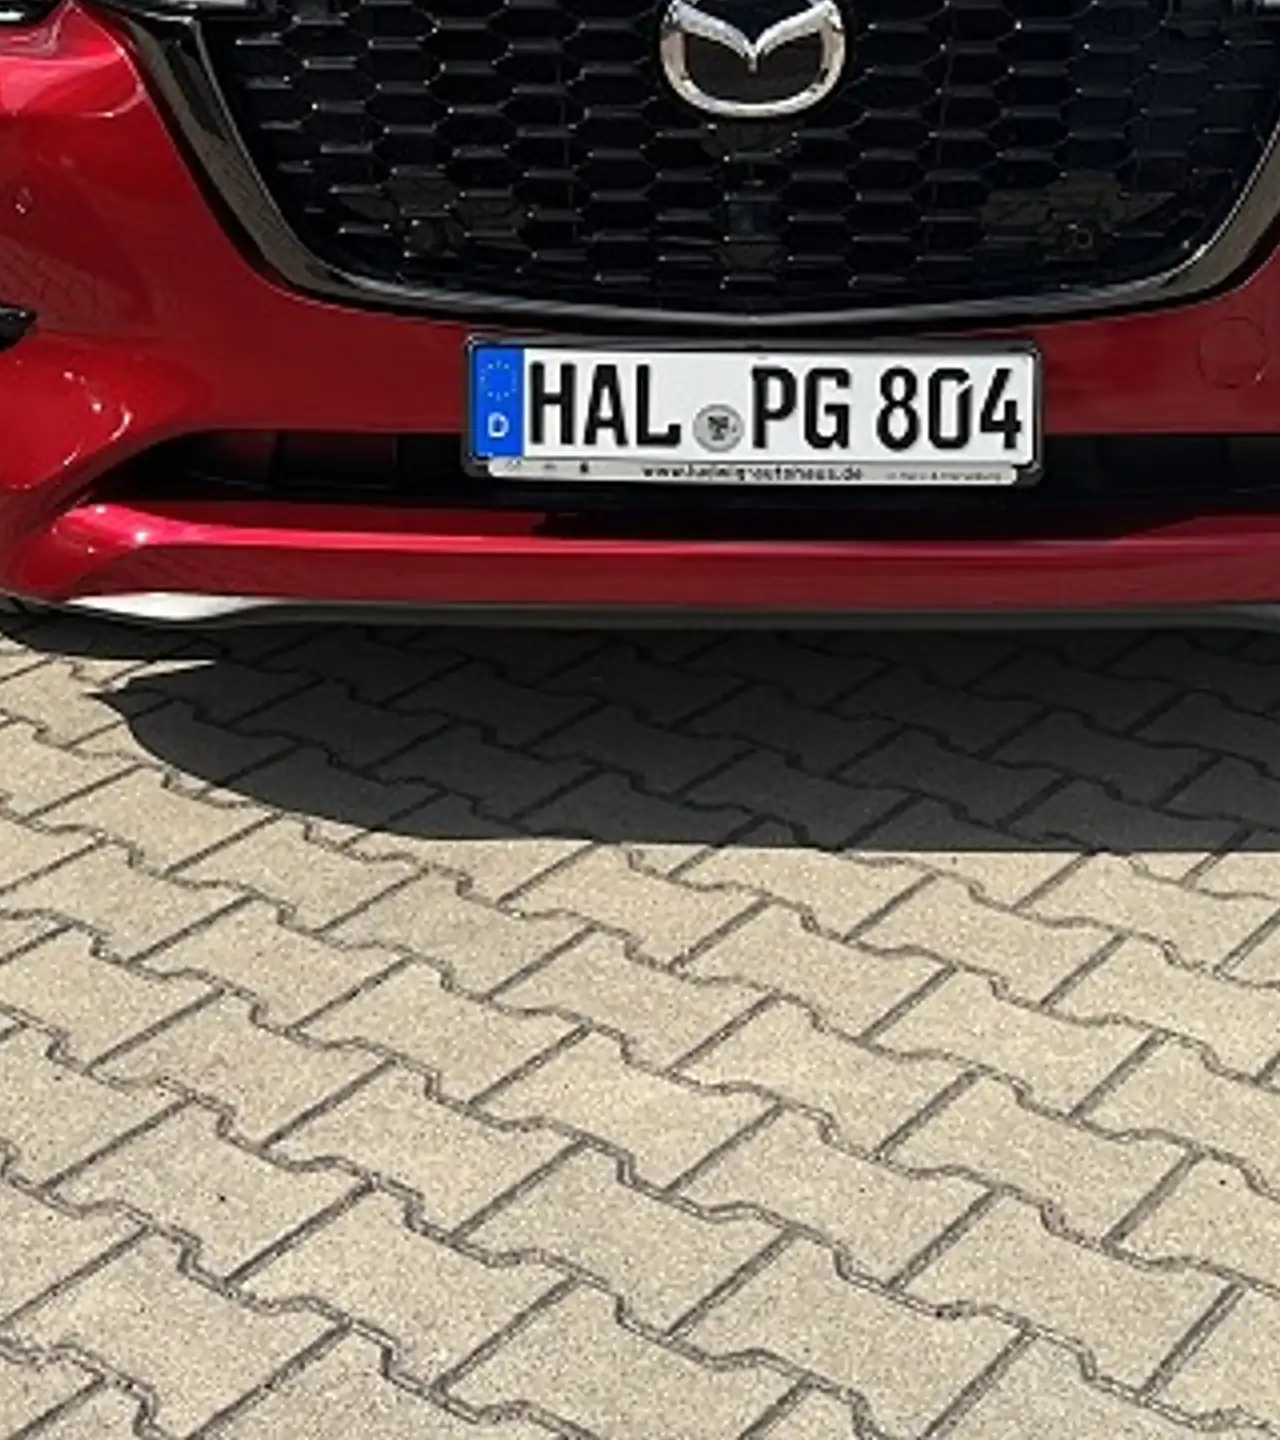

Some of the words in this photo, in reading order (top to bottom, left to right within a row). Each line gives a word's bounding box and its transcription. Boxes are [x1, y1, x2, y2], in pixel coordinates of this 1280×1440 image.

[488, 413, 511, 438] D
[528, 361, 681, 447] HAL
[751, 364, 852, 450] PG
[875, 367, 1023, 451] 804
